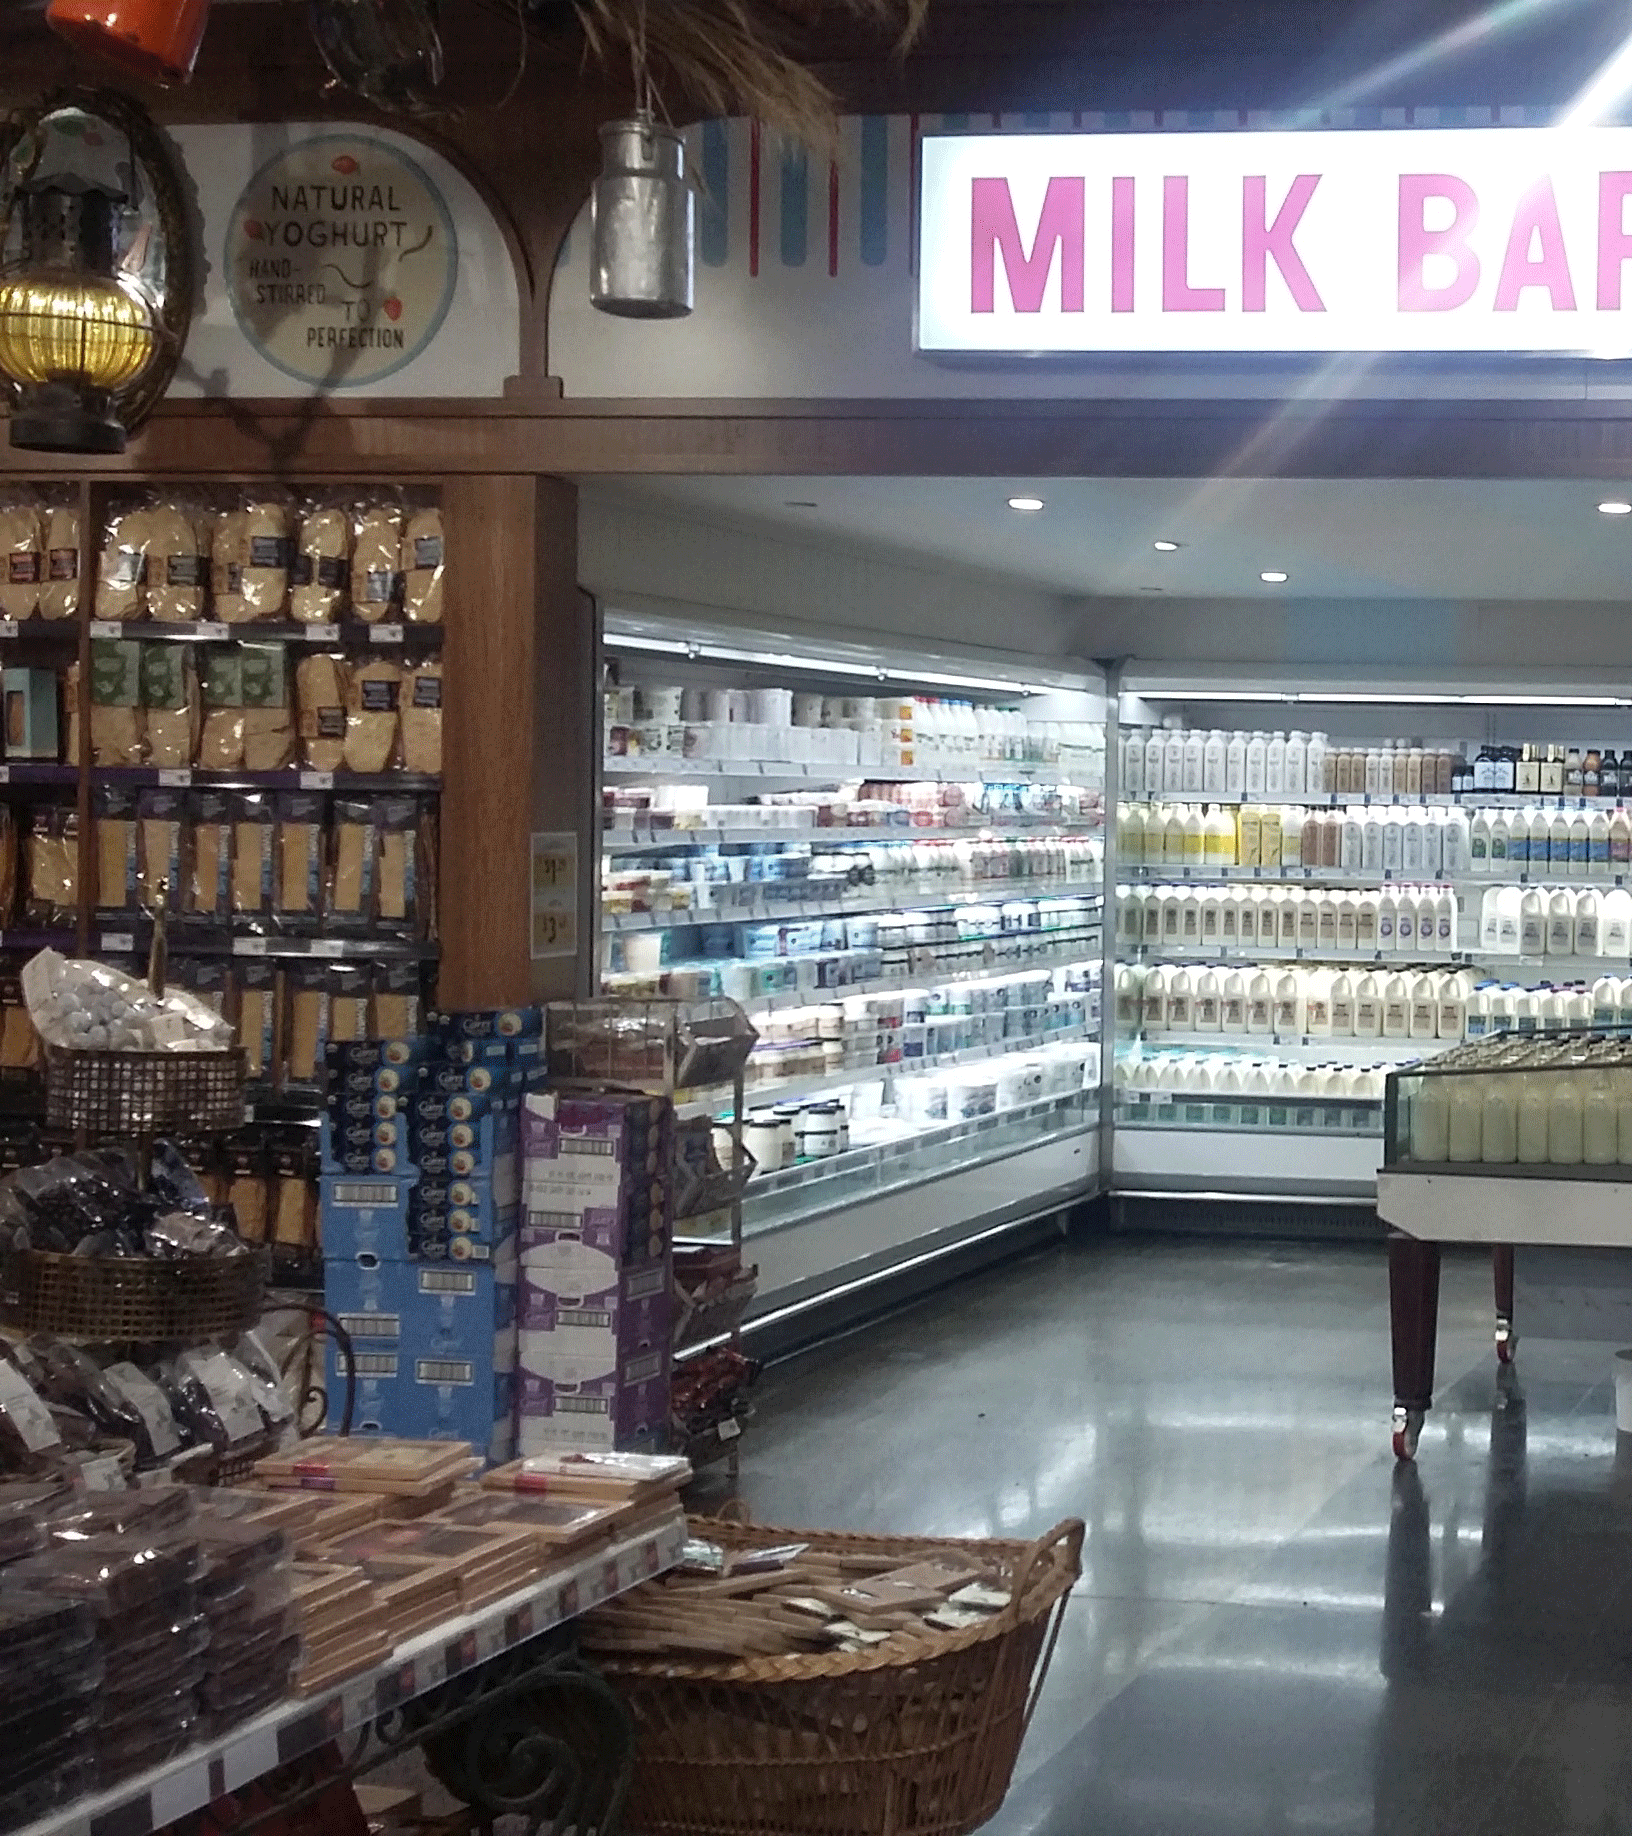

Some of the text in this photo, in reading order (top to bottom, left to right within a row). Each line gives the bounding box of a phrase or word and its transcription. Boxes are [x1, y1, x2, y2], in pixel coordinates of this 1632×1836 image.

[271, 184, 401, 212] NATURAL
[264, 220, 408, 248] YOGHURT
[969, 174, 1324, 314] MILK
[256, 283, 326, 305] STIRRED
[341, 298, 371, 322] TO
[306, 326, 405, 349] PERFECTION
